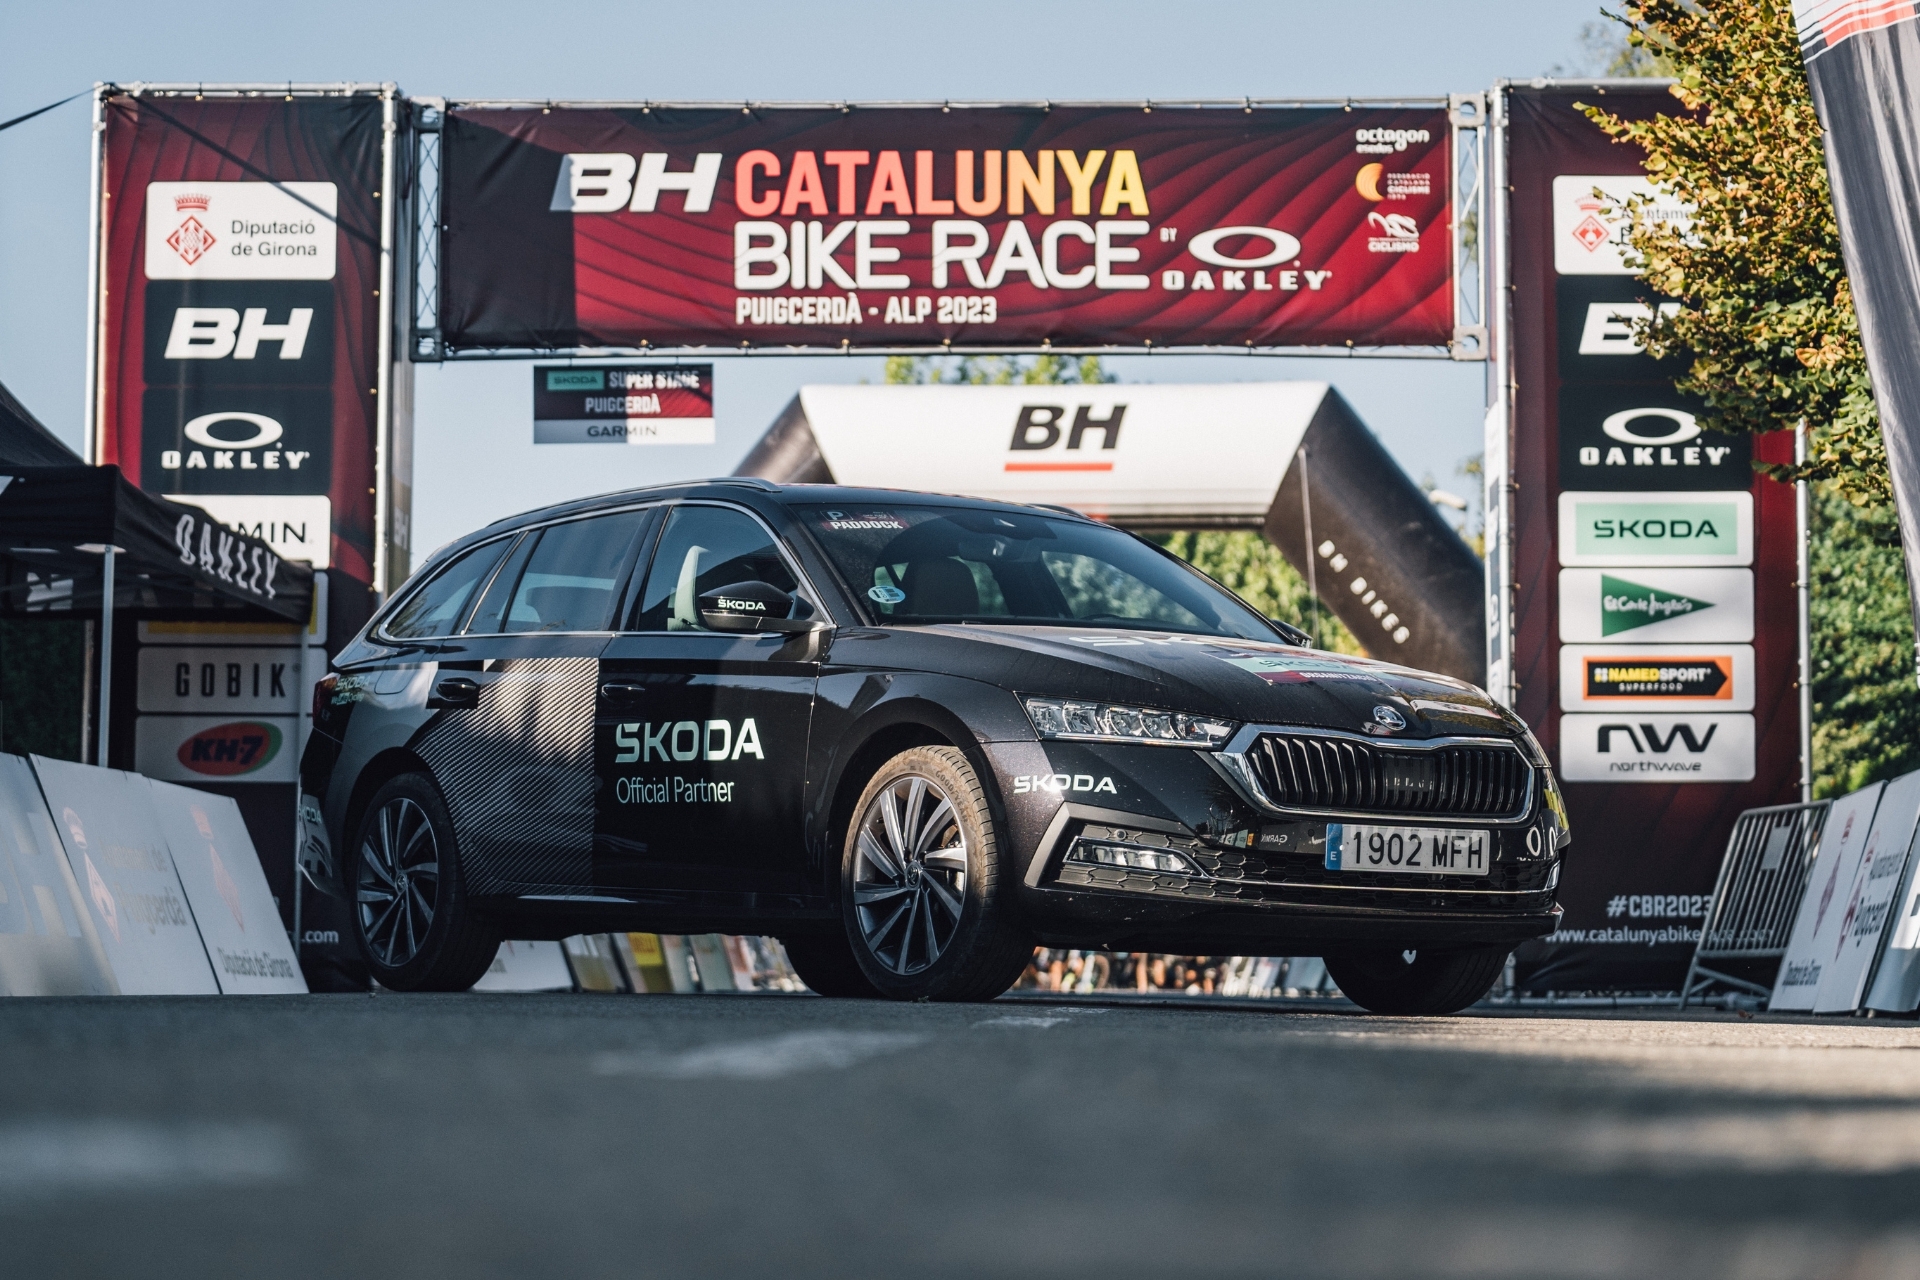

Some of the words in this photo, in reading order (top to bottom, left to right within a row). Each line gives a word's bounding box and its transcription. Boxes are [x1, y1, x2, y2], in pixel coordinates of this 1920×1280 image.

[1355, 128, 1430, 151] octagon
[549, 152, 723, 212] BH
[734, 149, 1150, 216] CATALUNYA
[231, 219, 315, 237] Diputació
[1159, 227, 1178, 242] BY
[231, 242, 253, 257] de
[258, 242, 317, 257] Girona
[733, 220, 911, 290] BIKE
[931, 219, 1150, 290] RACE
[1161, 270, 1327, 291] OAKLEY
[735, 291, 863, 325] PUIGCERDÀ
[884, 296, 932, 324] ALP
[937, 296, 998, 324] 2023
[163, 307, 314, 360] BH
[609, 371, 654, 389] SUPER
[585, 393, 661, 414] PUIGCERDÀ
[587, 425, 657, 437] GARMIN
[1009, 405, 1127, 450] BH
[161, 450, 310, 469] OAKLEY
[1579, 446, 1731, 466] OAKLEY
[237, 522, 306, 543] MIN
[829, 520, 904, 530] PADDOCK
[175, 513, 279, 600] OAKLEY
[1349, 576, 1411, 645] BIKES
[175, 662, 286, 698] GOBIK
[1619, 682, 1683, 692] SUPERFOOD
[1609, 762, 1702, 772] northwave
[616, 776, 670, 805] Official
[673, 776, 735, 805] Partner
[935, 770, 969, 824] GOODYEAR
[299, 804, 323, 824] KODA
[1330, 851, 1338, 862] E
[1352, 830, 1422, 868] 1902
[1432, 833, 1484, 870] MFH
[1607, 895, 1712, 917] #CBR2023
